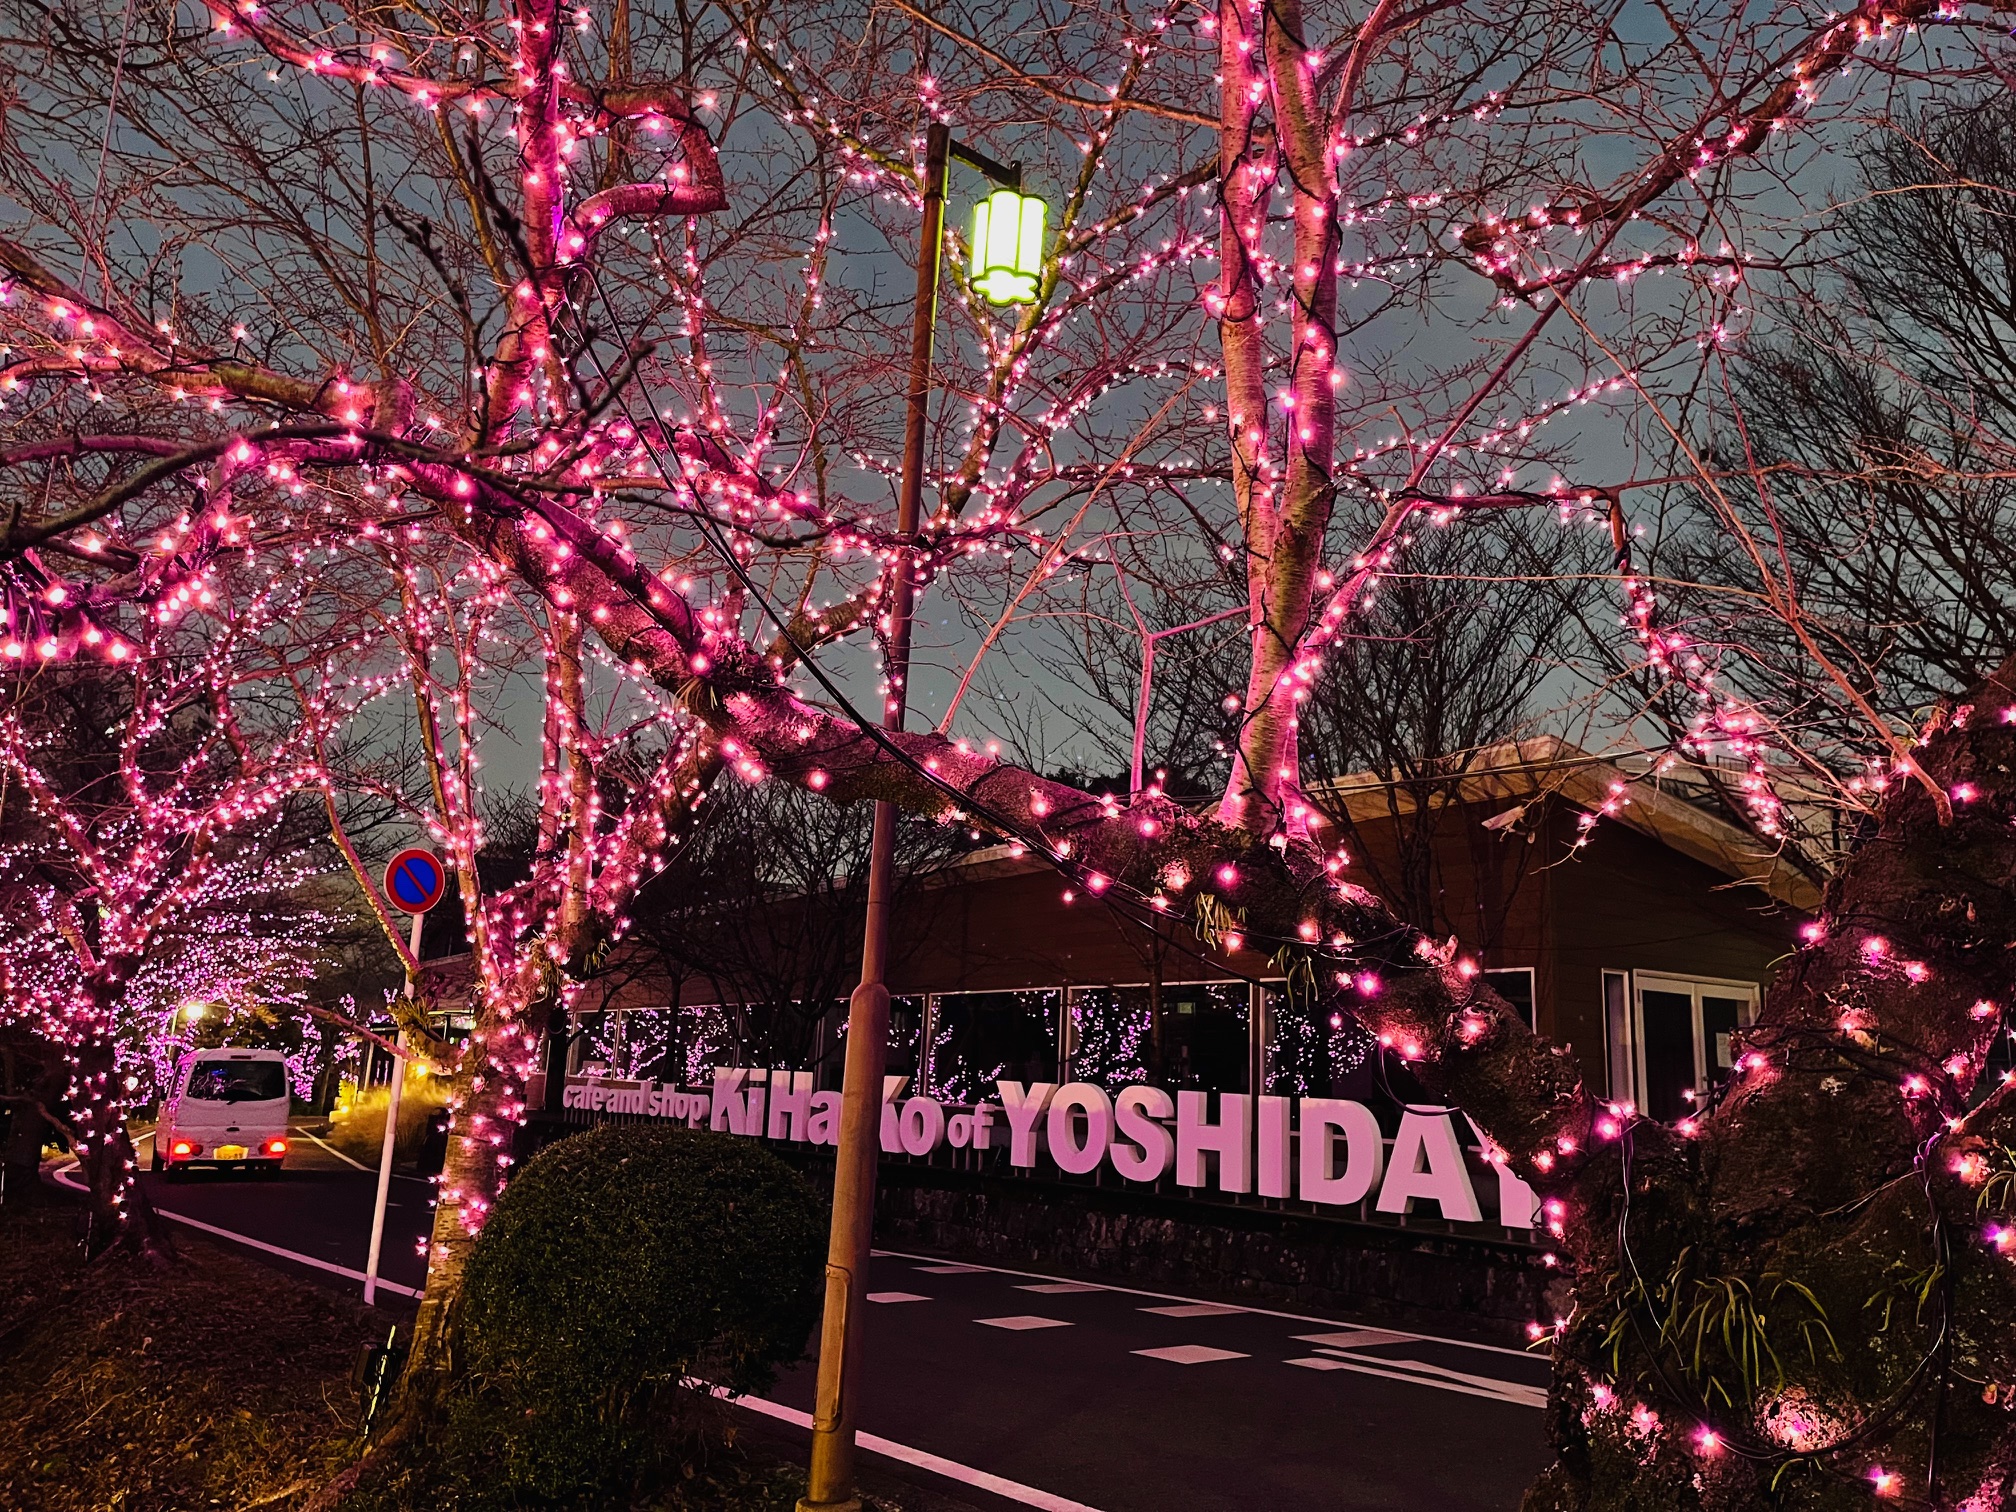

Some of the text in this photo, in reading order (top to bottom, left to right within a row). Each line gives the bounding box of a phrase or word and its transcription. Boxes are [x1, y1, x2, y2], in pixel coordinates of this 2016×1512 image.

[563, 1077, 607, 1112] cafe
[606, 1081, 652, 1115] and
[648, 1083, 710, 1130] shop
[947, 1103, 996, 1150] of
